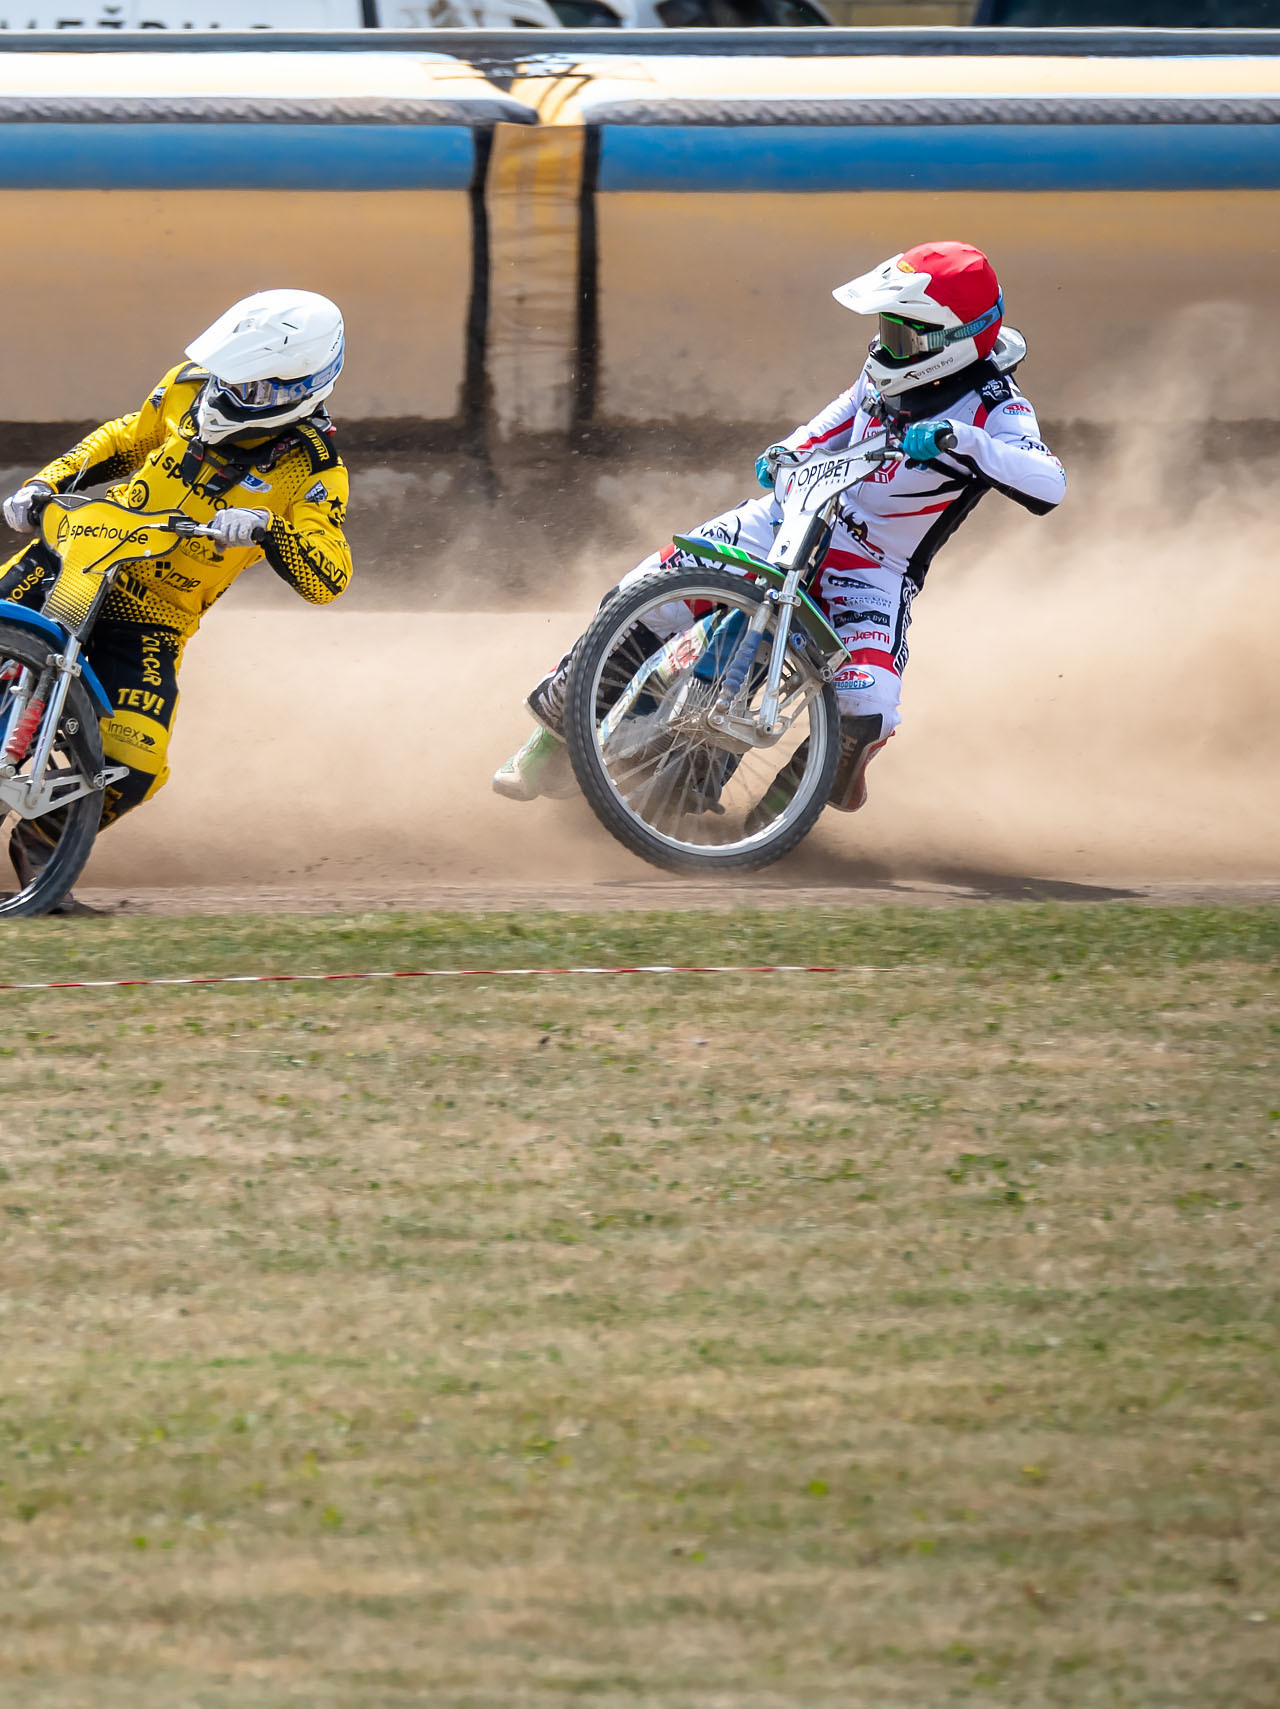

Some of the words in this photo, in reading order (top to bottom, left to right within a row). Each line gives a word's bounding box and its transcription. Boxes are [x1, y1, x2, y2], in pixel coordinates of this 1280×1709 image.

[797, 457, 852, 487] OPTIBET
[70, 523, 149, 545] spechouse
[117, 688, 166, 716] TEY!
